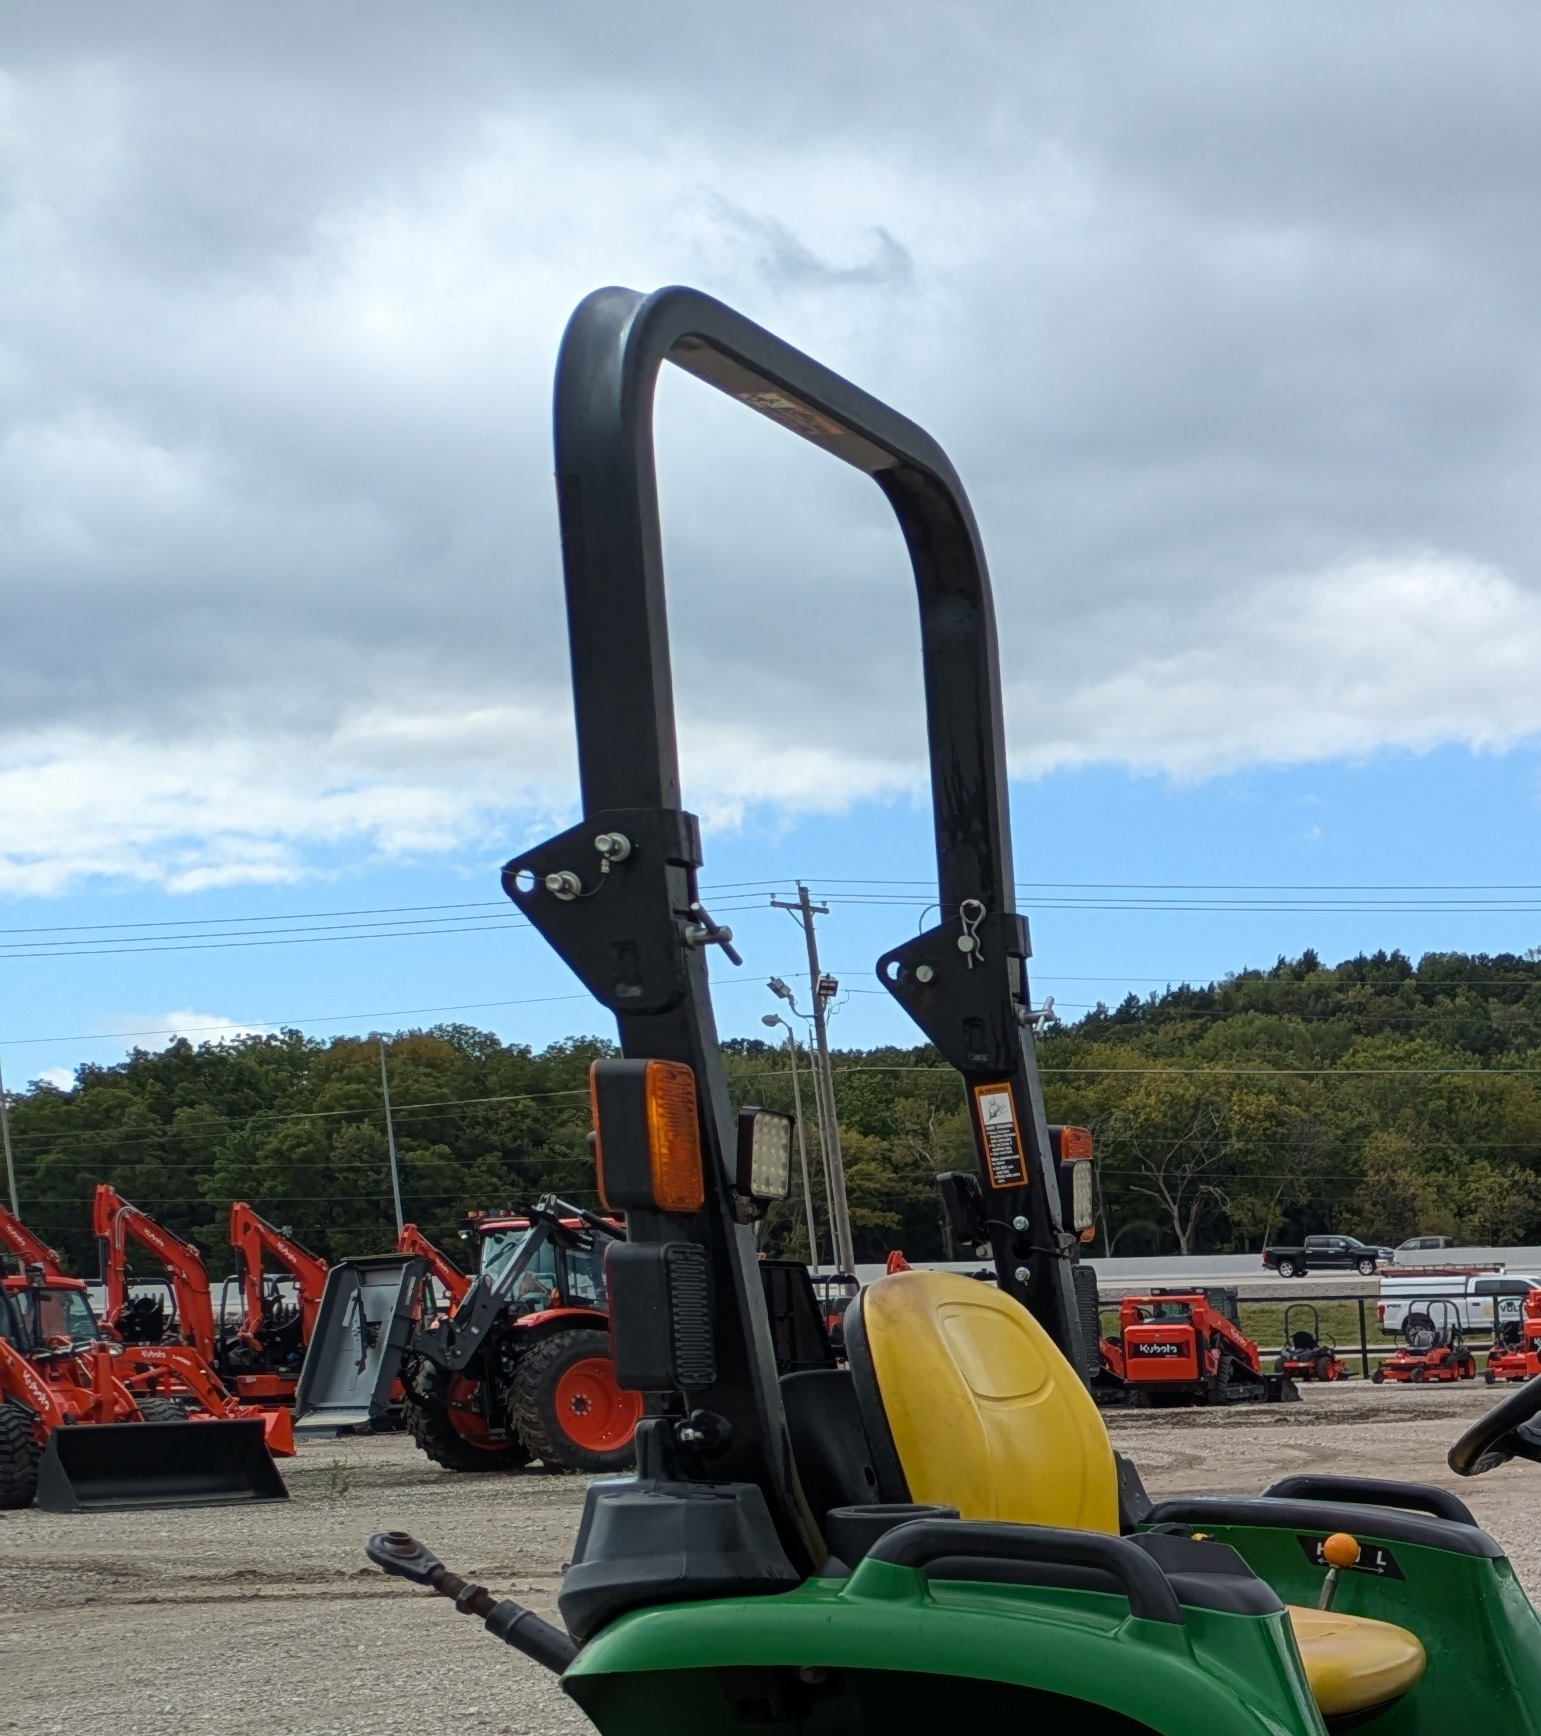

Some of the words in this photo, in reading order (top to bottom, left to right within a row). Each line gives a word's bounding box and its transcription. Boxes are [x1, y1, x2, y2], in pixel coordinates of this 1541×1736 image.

[141, 1349, 166, 1359] Kubota
[1140, 1343, 1178, 1354] Kubota
[22, 1369, 50, 1411] Kubota
